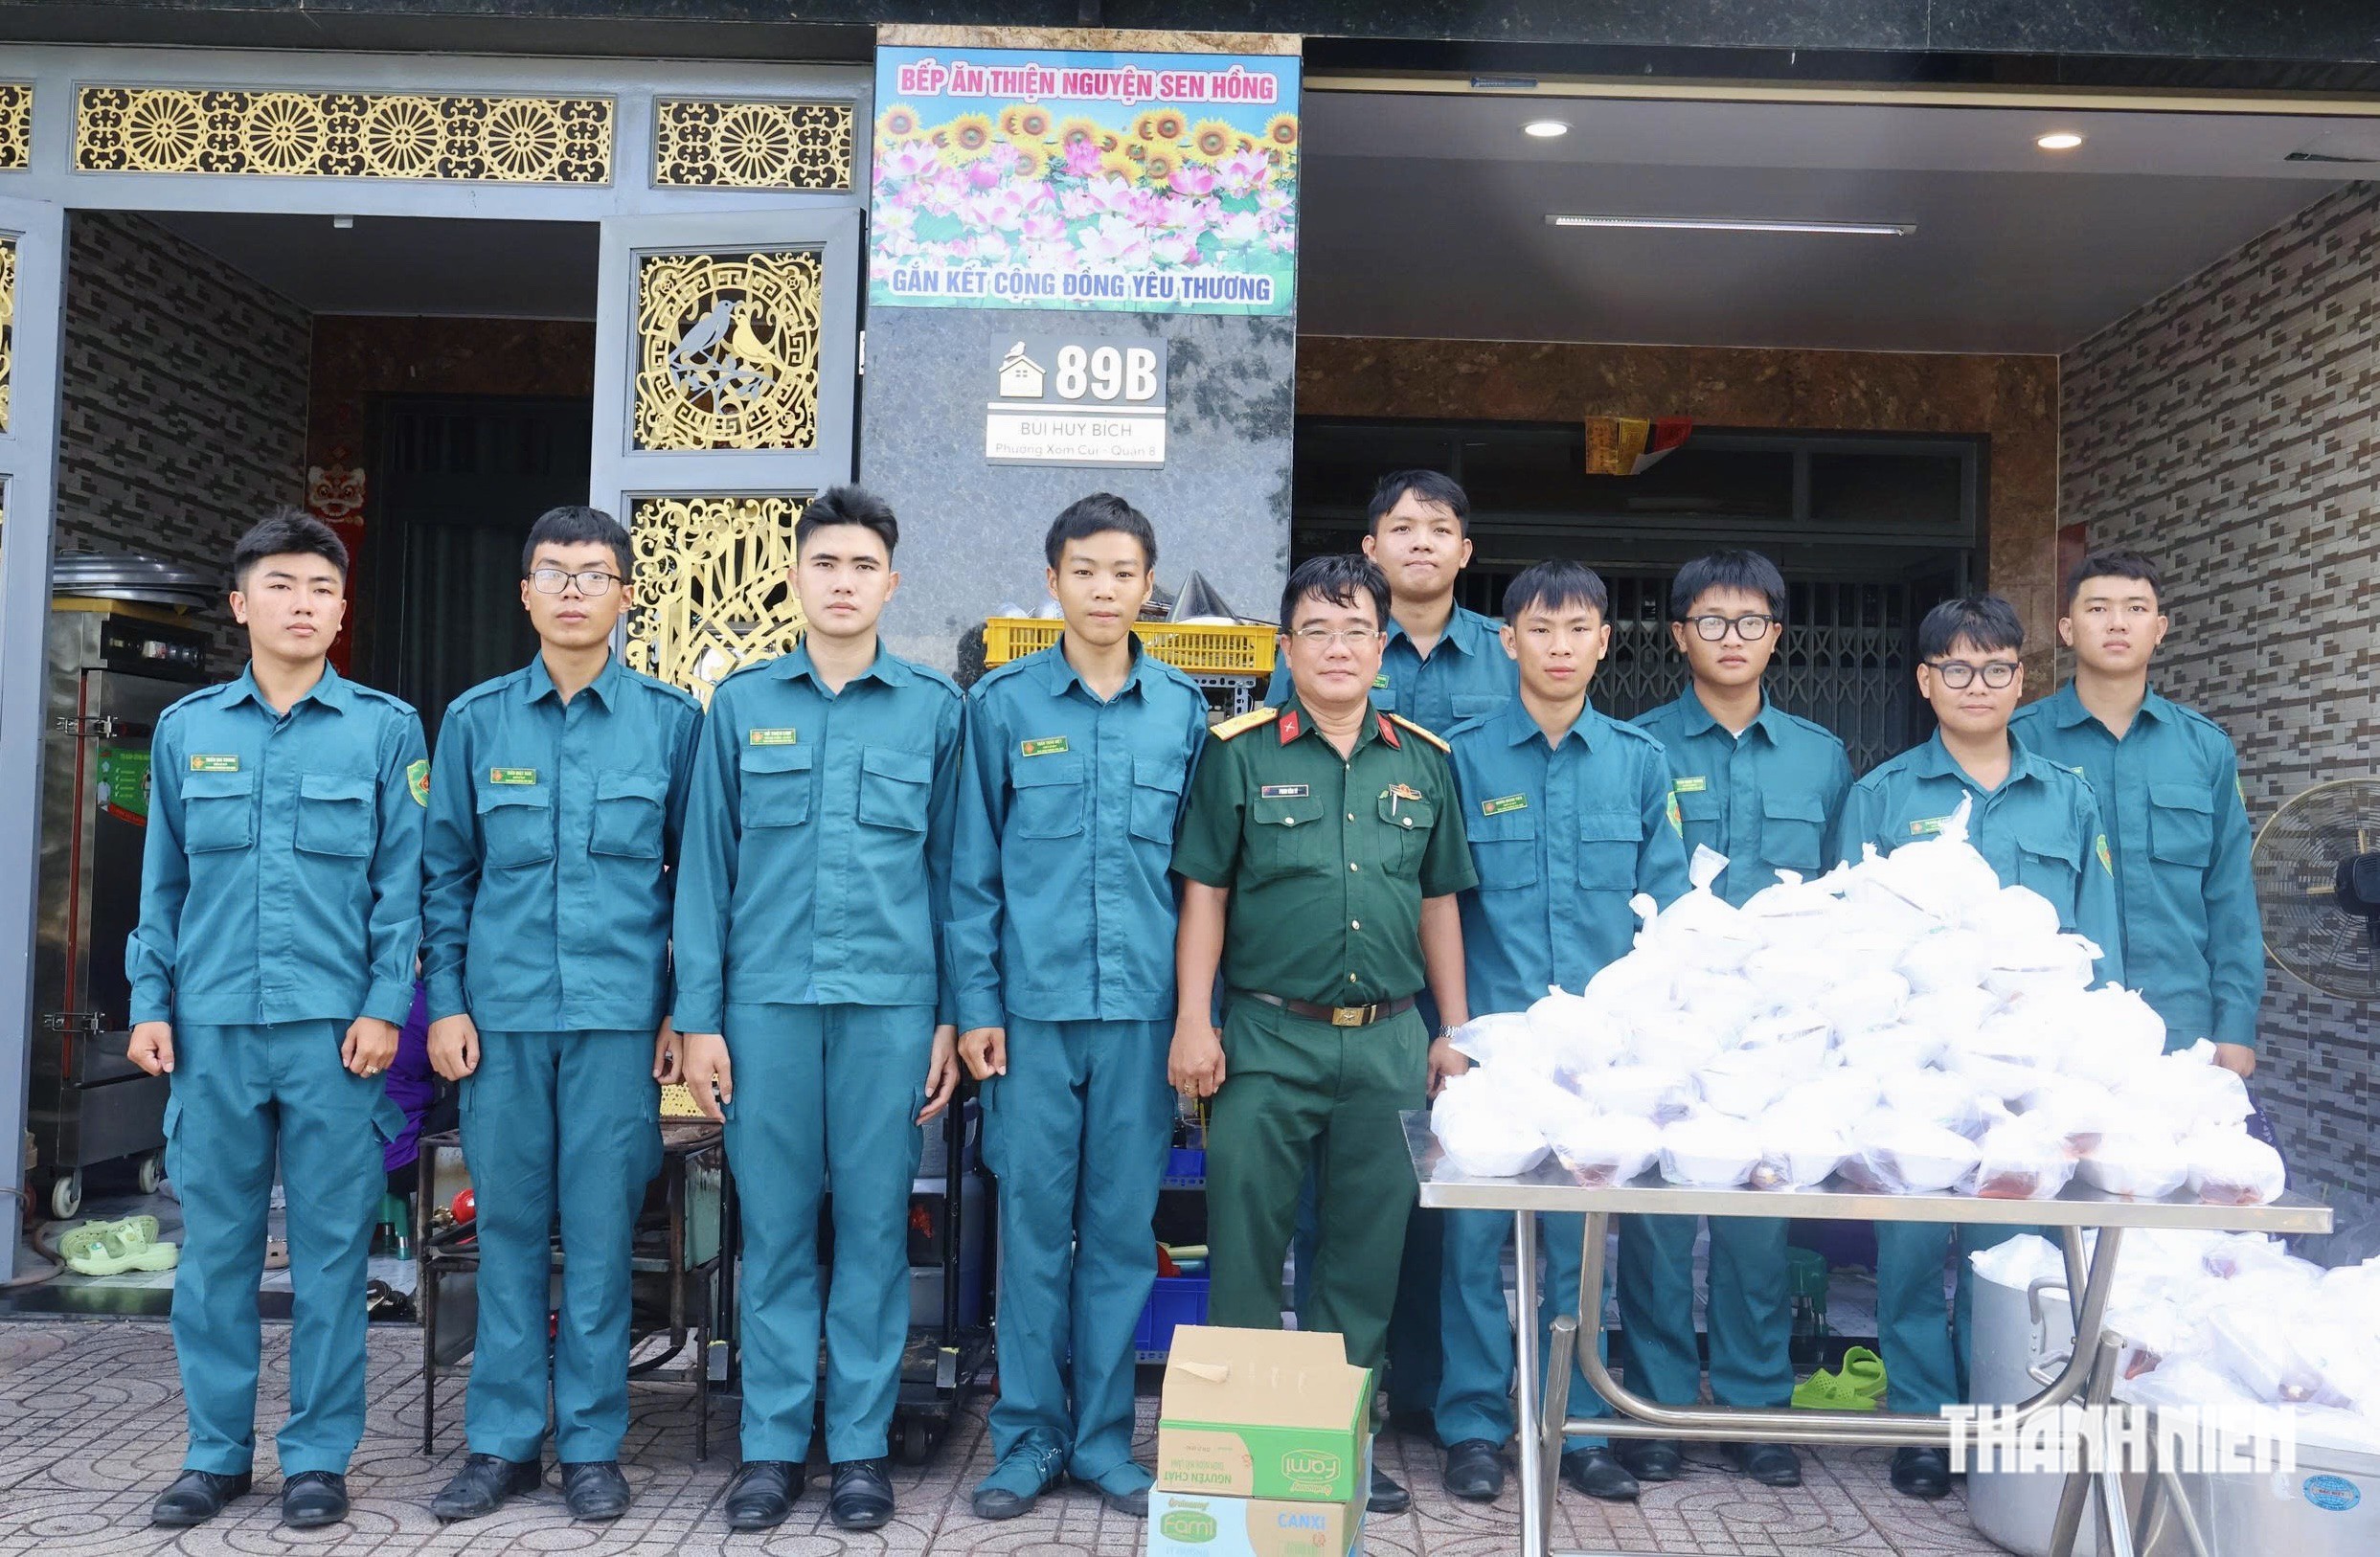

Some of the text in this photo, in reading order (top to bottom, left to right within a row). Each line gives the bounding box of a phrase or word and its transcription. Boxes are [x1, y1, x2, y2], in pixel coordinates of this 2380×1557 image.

[901, 62, 1274, 101] BẾP ĂN THIỆN NGUYỆN SEN HỒNG
[893, 260, 1270, 301] GẮN KẾT CỘNG ĐỒNG YÊU THƯƠNG
[1055, 345, 1158, 400] 89B
[1053, 422, 1087, 437] HUY
[1148, 446, 1156, 457] 8
